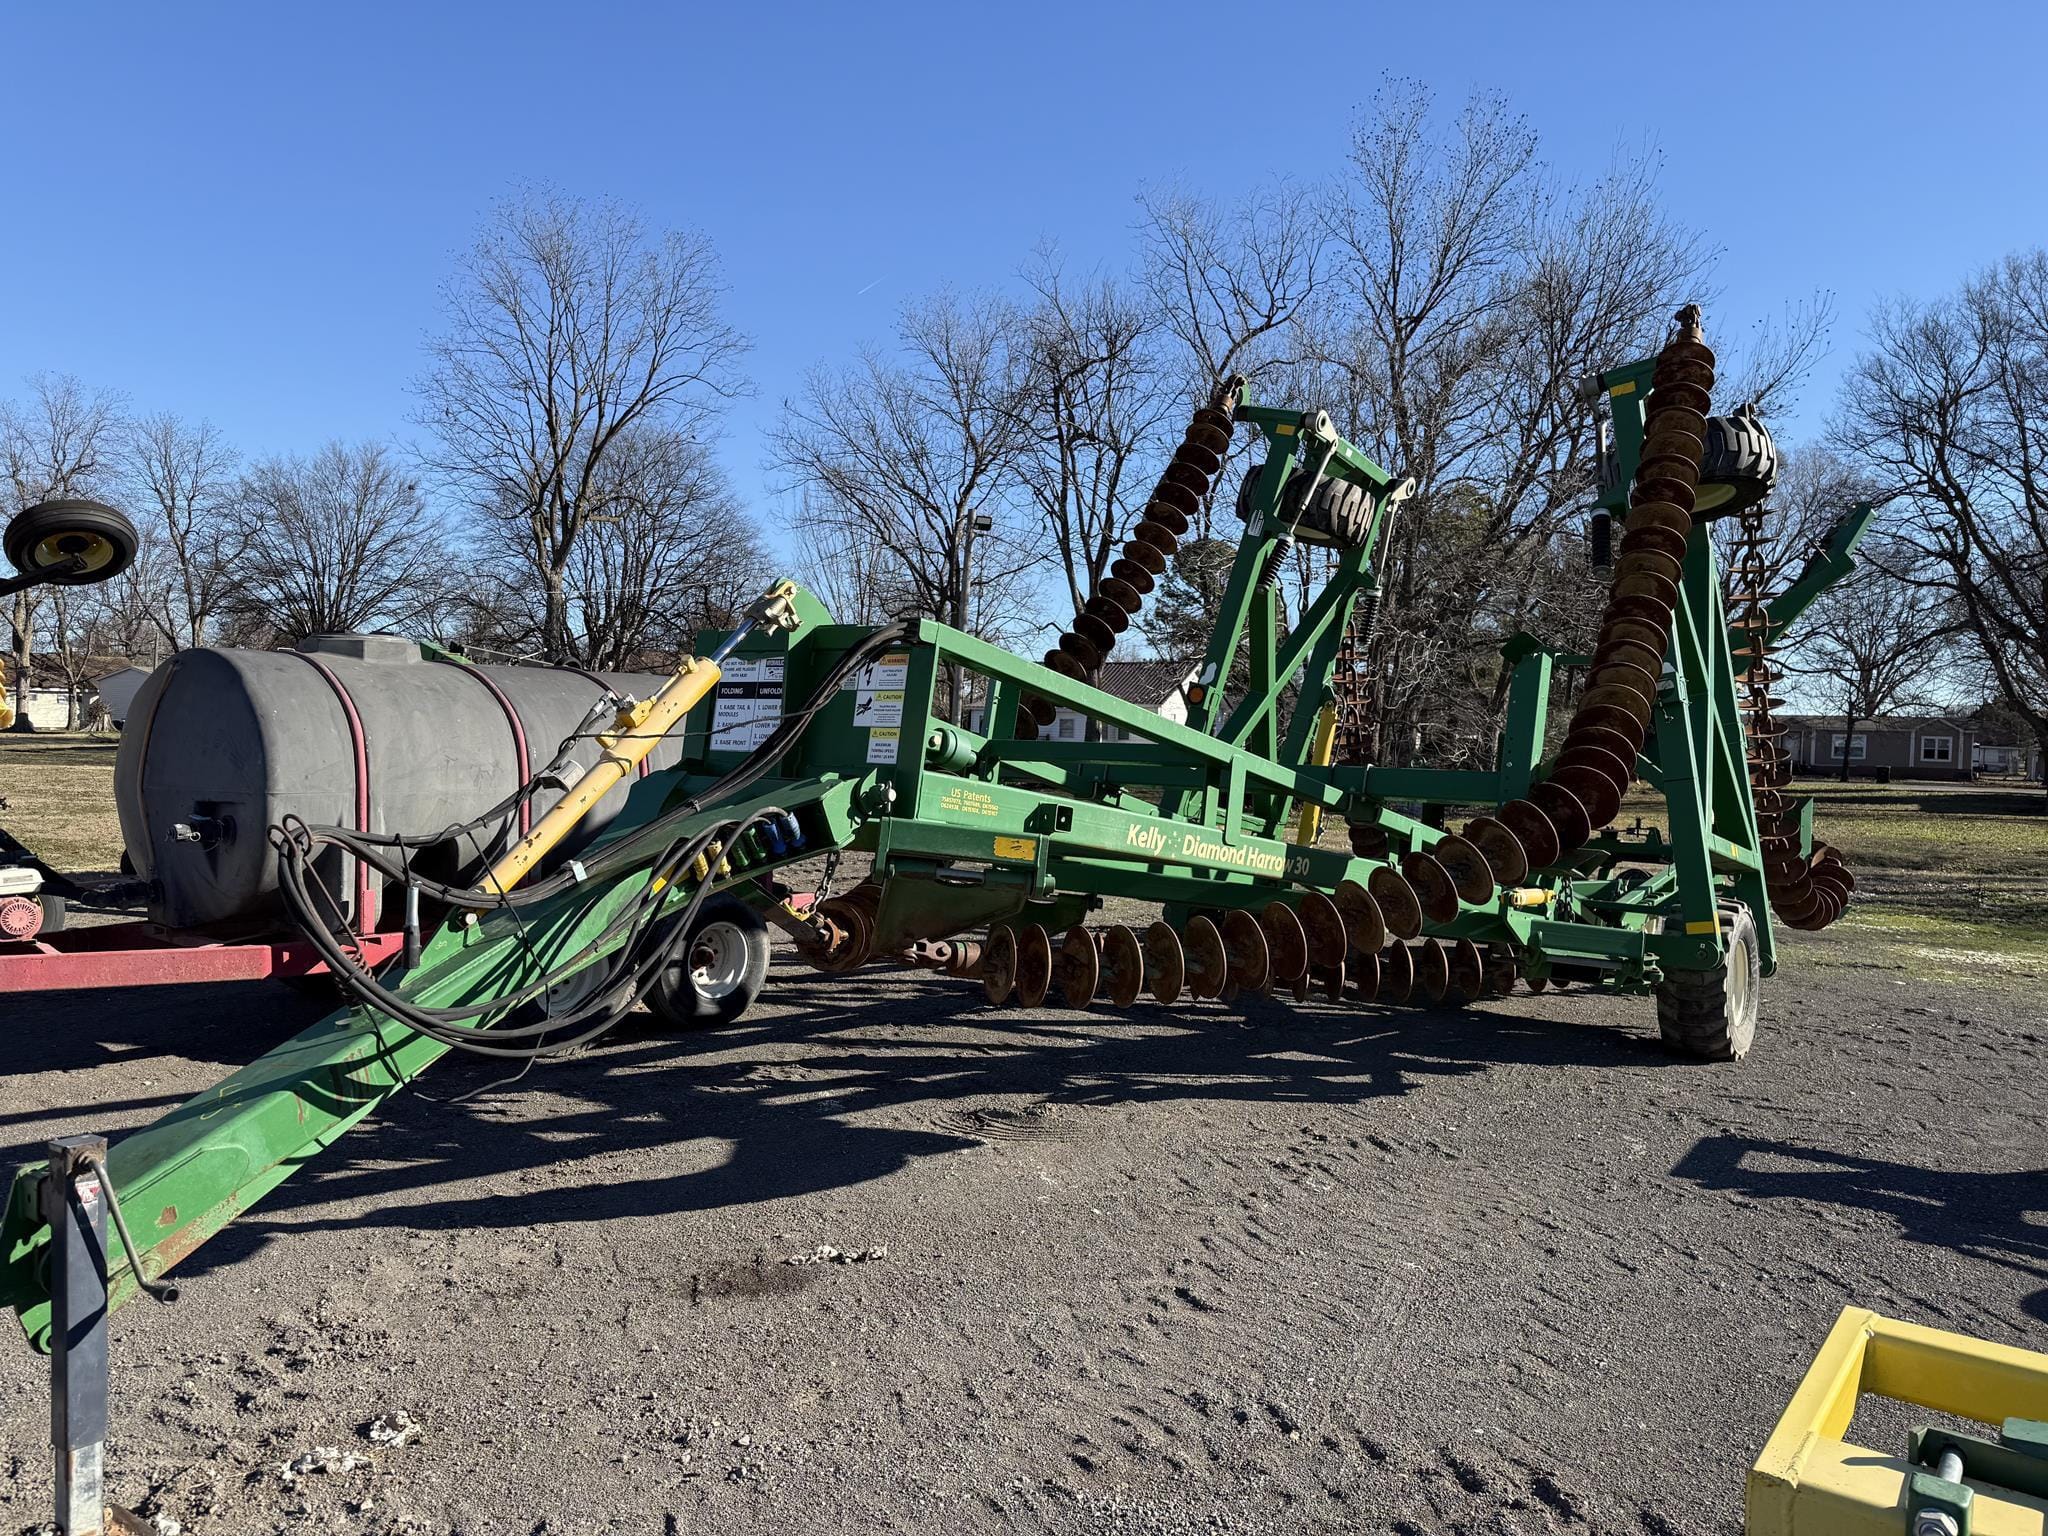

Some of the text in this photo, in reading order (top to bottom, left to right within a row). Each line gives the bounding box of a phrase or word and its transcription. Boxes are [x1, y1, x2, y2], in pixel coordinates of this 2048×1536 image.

[951, 787, 992, 803] US Patents
[1126, 823, 1310, 876] Kelly Diamond Harrow 30
